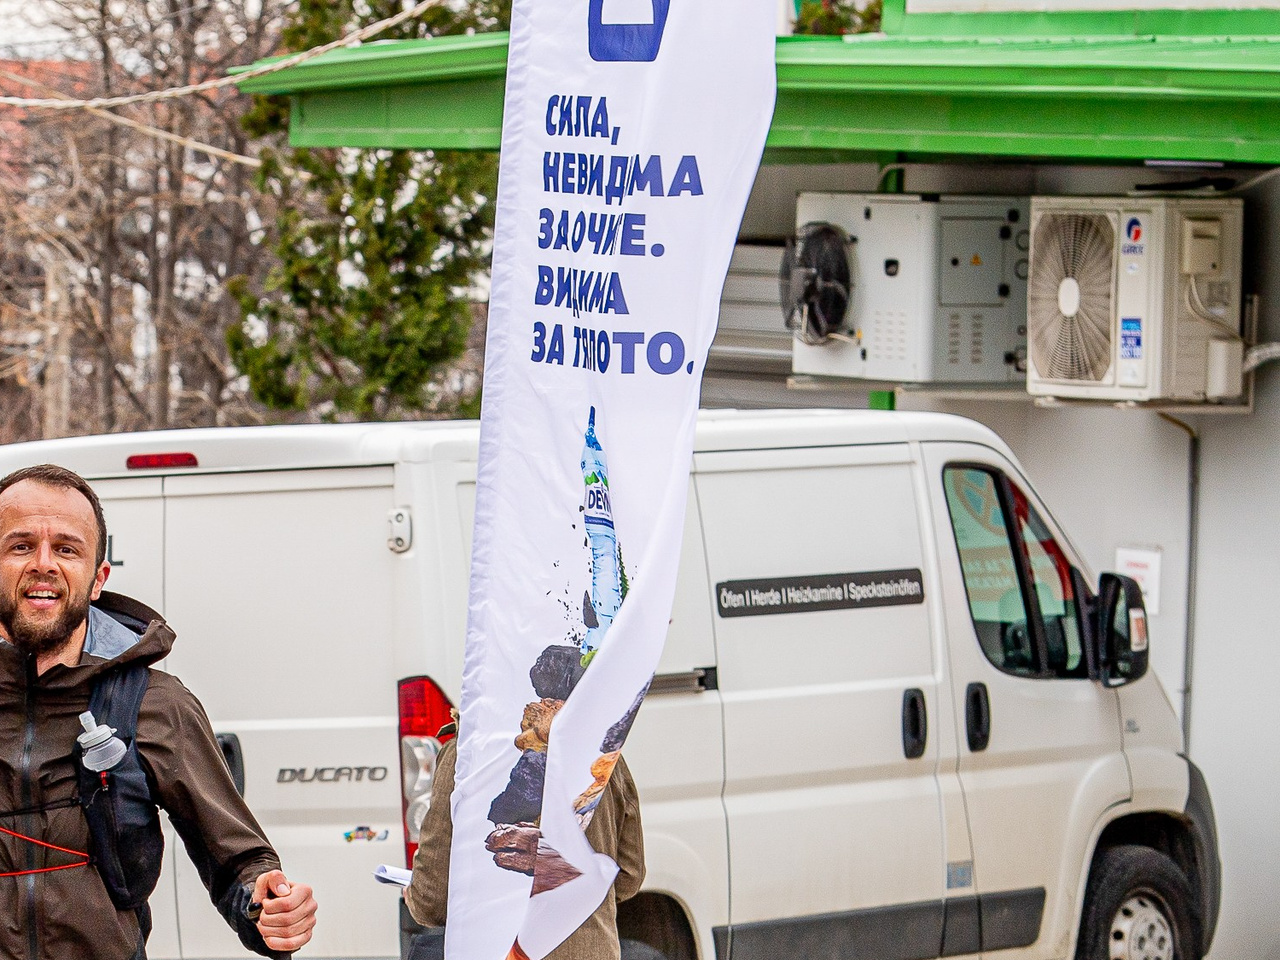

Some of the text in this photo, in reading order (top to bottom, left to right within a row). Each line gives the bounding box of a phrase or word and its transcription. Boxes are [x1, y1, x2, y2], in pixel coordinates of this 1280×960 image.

[545, 94, 620, 145] СИЛА,
[531, 322, 565, 366] ЗА
[277, 766, 388, 783] DUCATO
